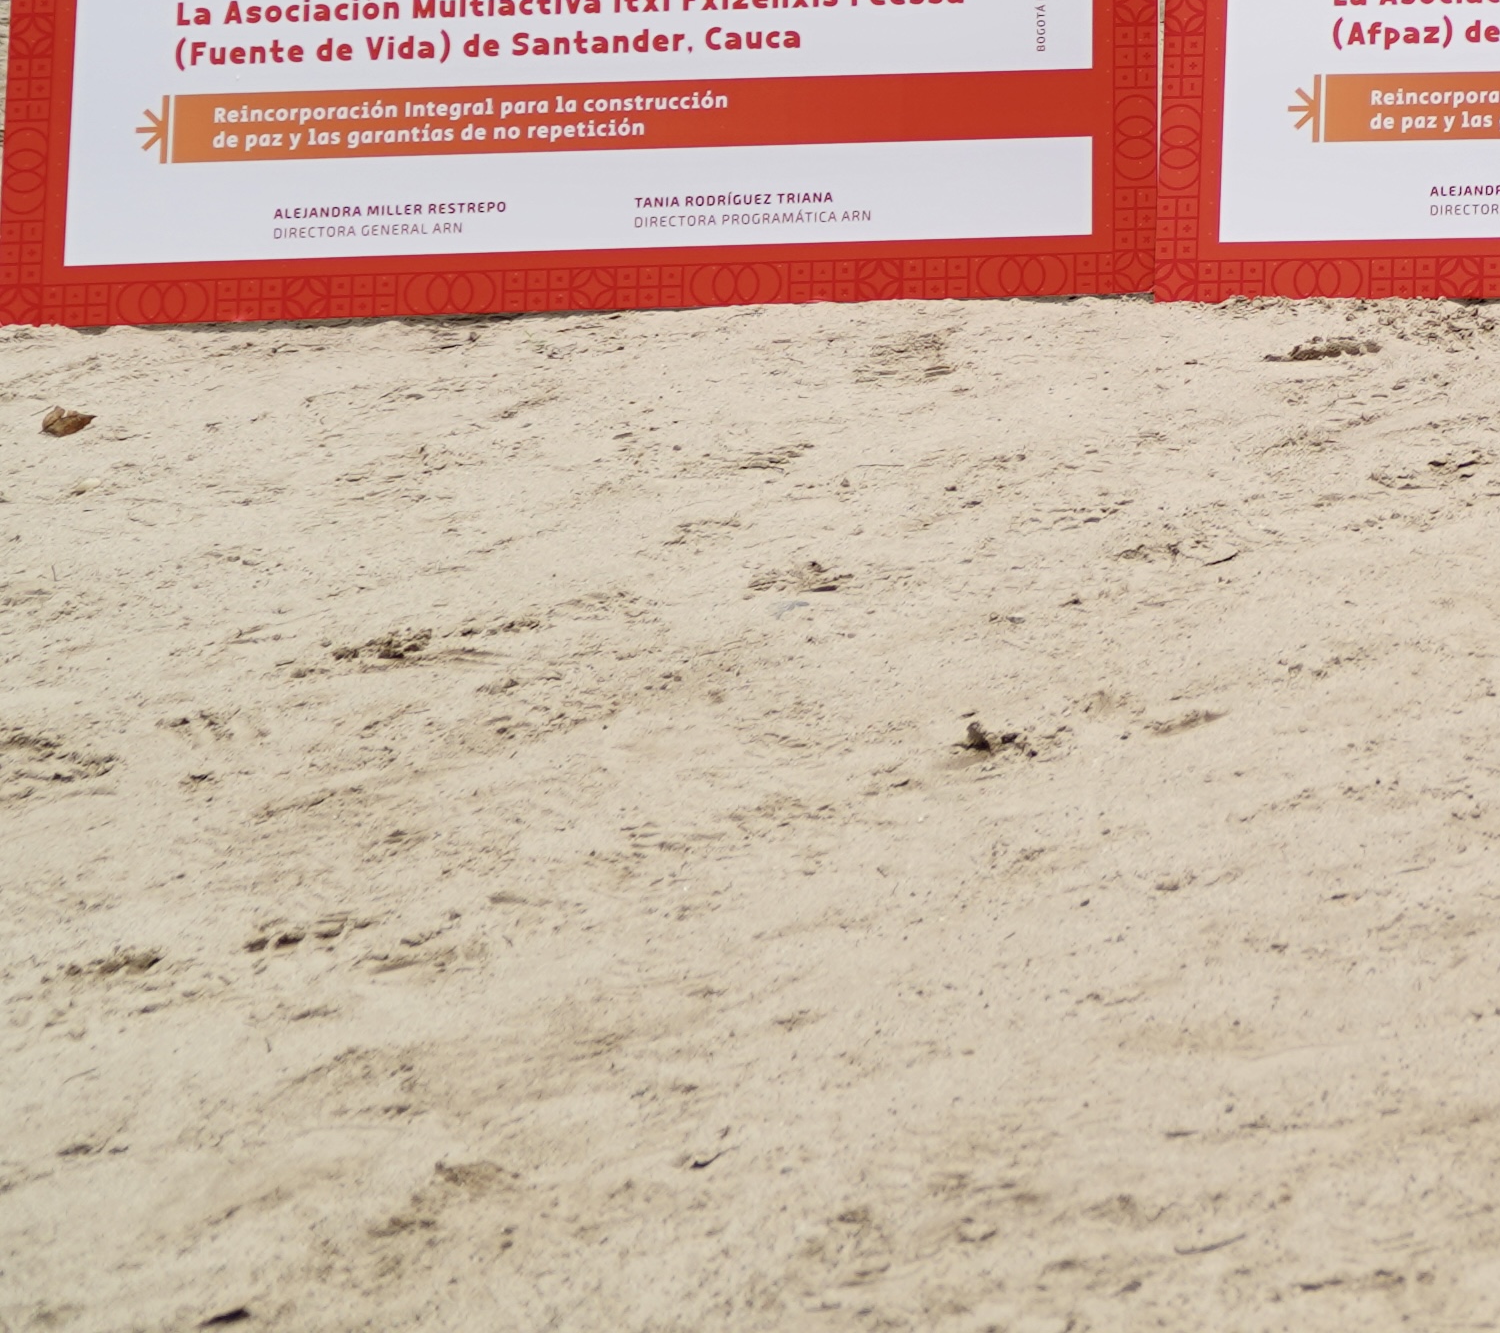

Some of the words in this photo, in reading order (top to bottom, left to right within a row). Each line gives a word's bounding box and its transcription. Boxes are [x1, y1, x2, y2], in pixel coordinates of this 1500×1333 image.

[176, 1, 211, 26] La
[175, 37, 304, 71] (Fuente
[316, 37, 353, 62] de
[365, 29, 450, 63] Vida)
[463, 33, 500, 58] de
[511, 28, 693, 56] Santander,
[705, 26, 801, 51] Cauca
